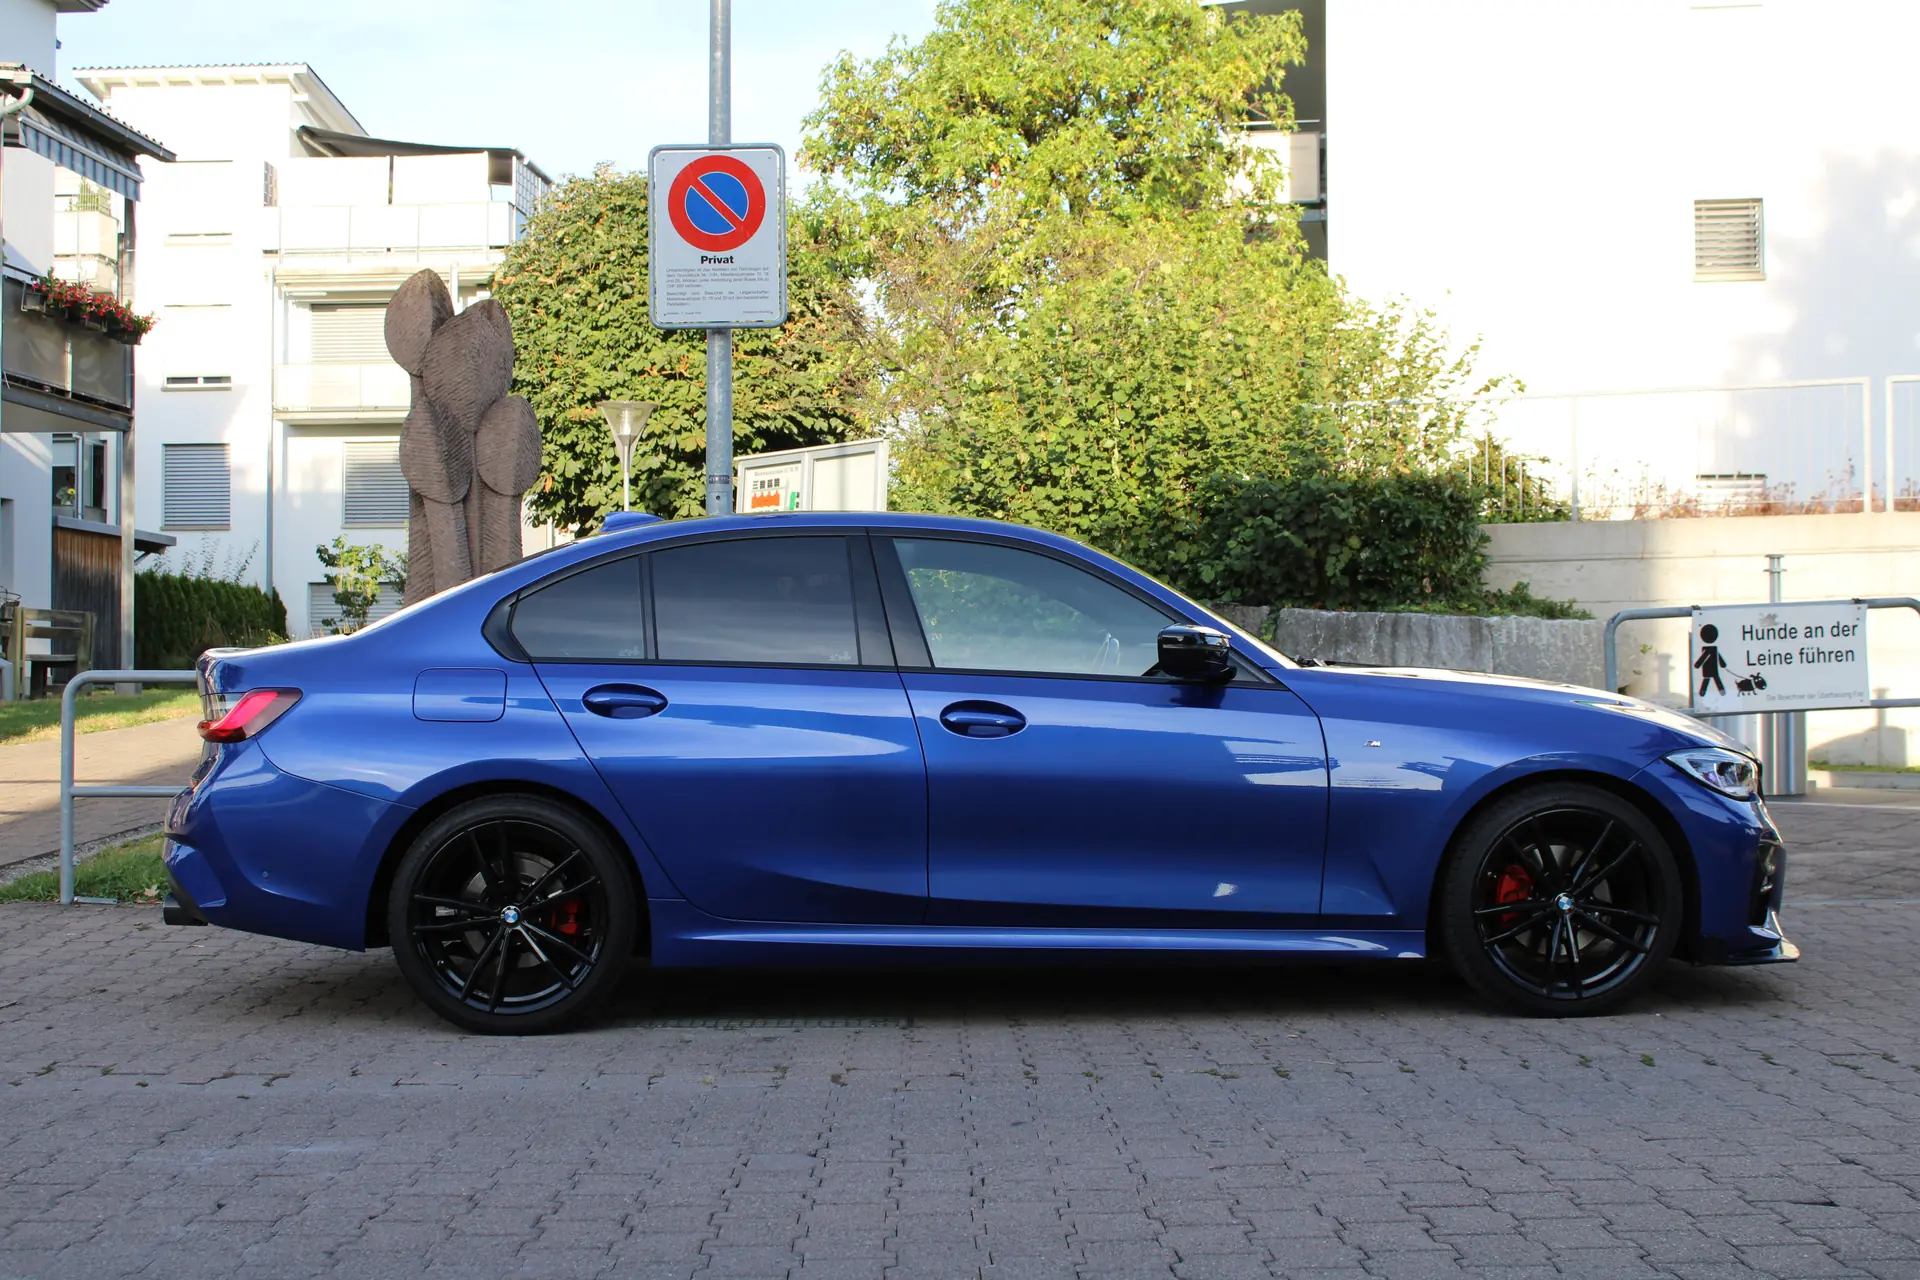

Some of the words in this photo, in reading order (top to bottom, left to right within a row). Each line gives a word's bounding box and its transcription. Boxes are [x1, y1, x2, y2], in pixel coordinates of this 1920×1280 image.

[701, 256, 734, 264] Privat
[1742, 623, 1798, 641] Hunde
[1804, 625, 1824, 638] an
[1830, 621, 1858, 637] der
[1746, 649, 1793, 666] Leine
[1799, 647, 1855, 664] führen
